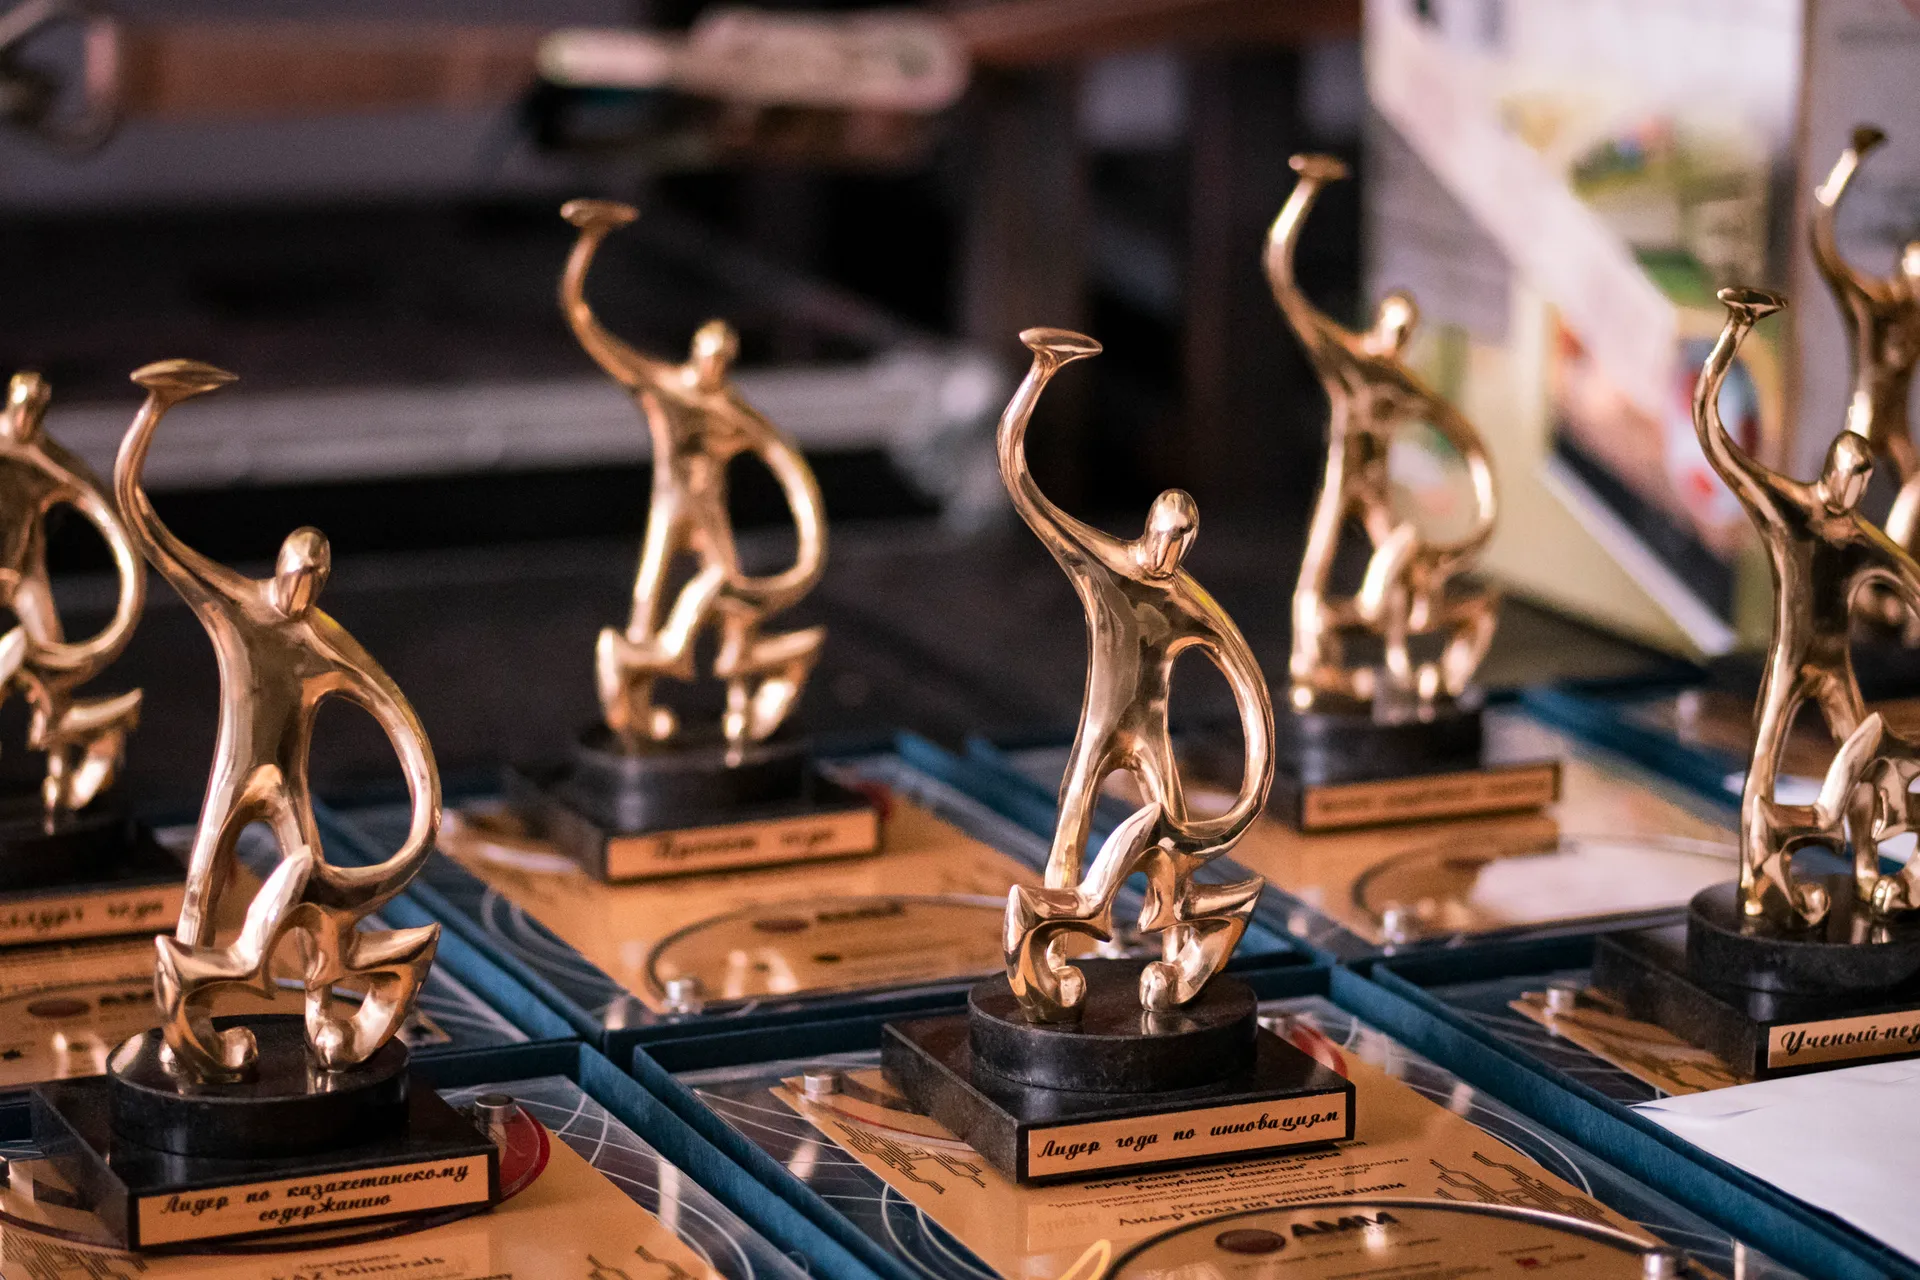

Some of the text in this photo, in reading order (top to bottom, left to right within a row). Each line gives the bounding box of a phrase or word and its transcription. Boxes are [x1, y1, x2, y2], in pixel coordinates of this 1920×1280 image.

[1037, 1111, 1338, 1160] Лидер года по инновациям
[1084, 1151, 1341, 1190] переработке минерального сырья
[1135, 1174, 1224, 1191] Республики
[160, 1165, 469, 1216] Лидер по казахстанскому
[259, 1193, 391, 1225] содержанию
[1119, 1182, 1406, 1226] Лидер года по инновациям
[336, 1256, 446, 1277] Minerals
